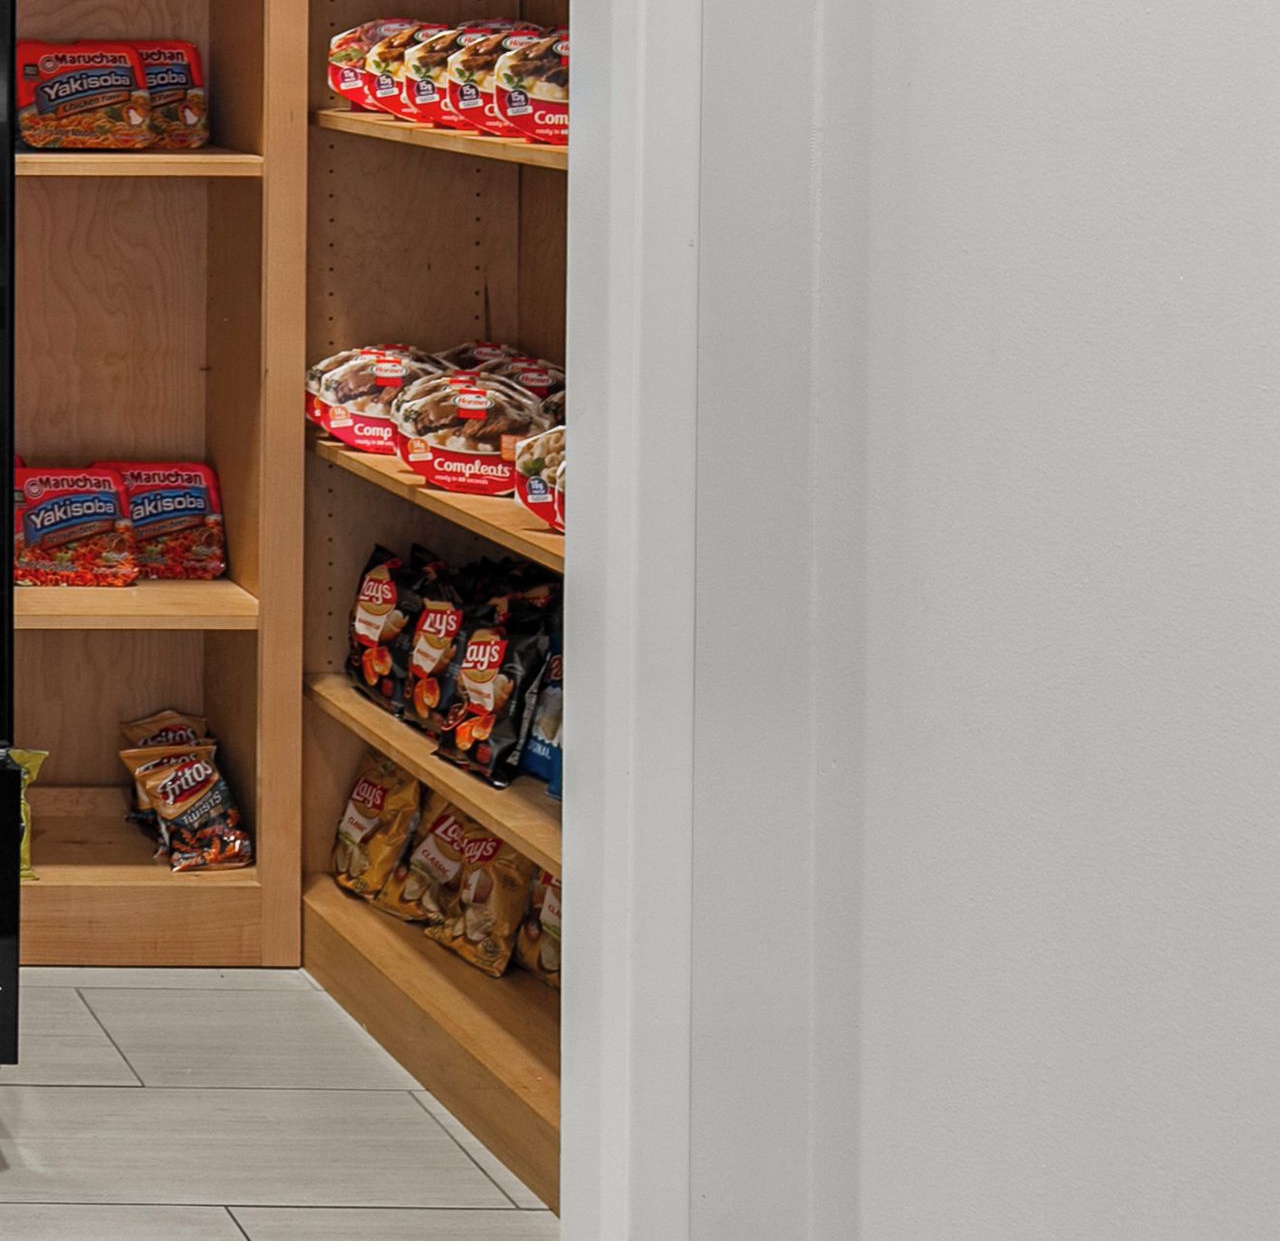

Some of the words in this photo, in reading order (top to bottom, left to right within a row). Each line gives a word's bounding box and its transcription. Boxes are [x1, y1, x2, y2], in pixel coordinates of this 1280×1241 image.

[56, 53, 129, 66] Maruchan
[140, 49, 185, 62] uchan
[43, 73, 131, 101] Yakisoba
[146, 71, 187, 87] soba
[457, 396, 490, 408] Hormel
[434, 457, 511, 478] Compleats
[38, 475, 112, 490] Maruchan
[130, 470, 203, 485] Maruchan
[30, 498, 115, 529] Yakisoba
[157, 758, 213, 806] Fritos
[352, 777, 383, 807] Lay's
[182, 791, 223, 825] TWISTS
